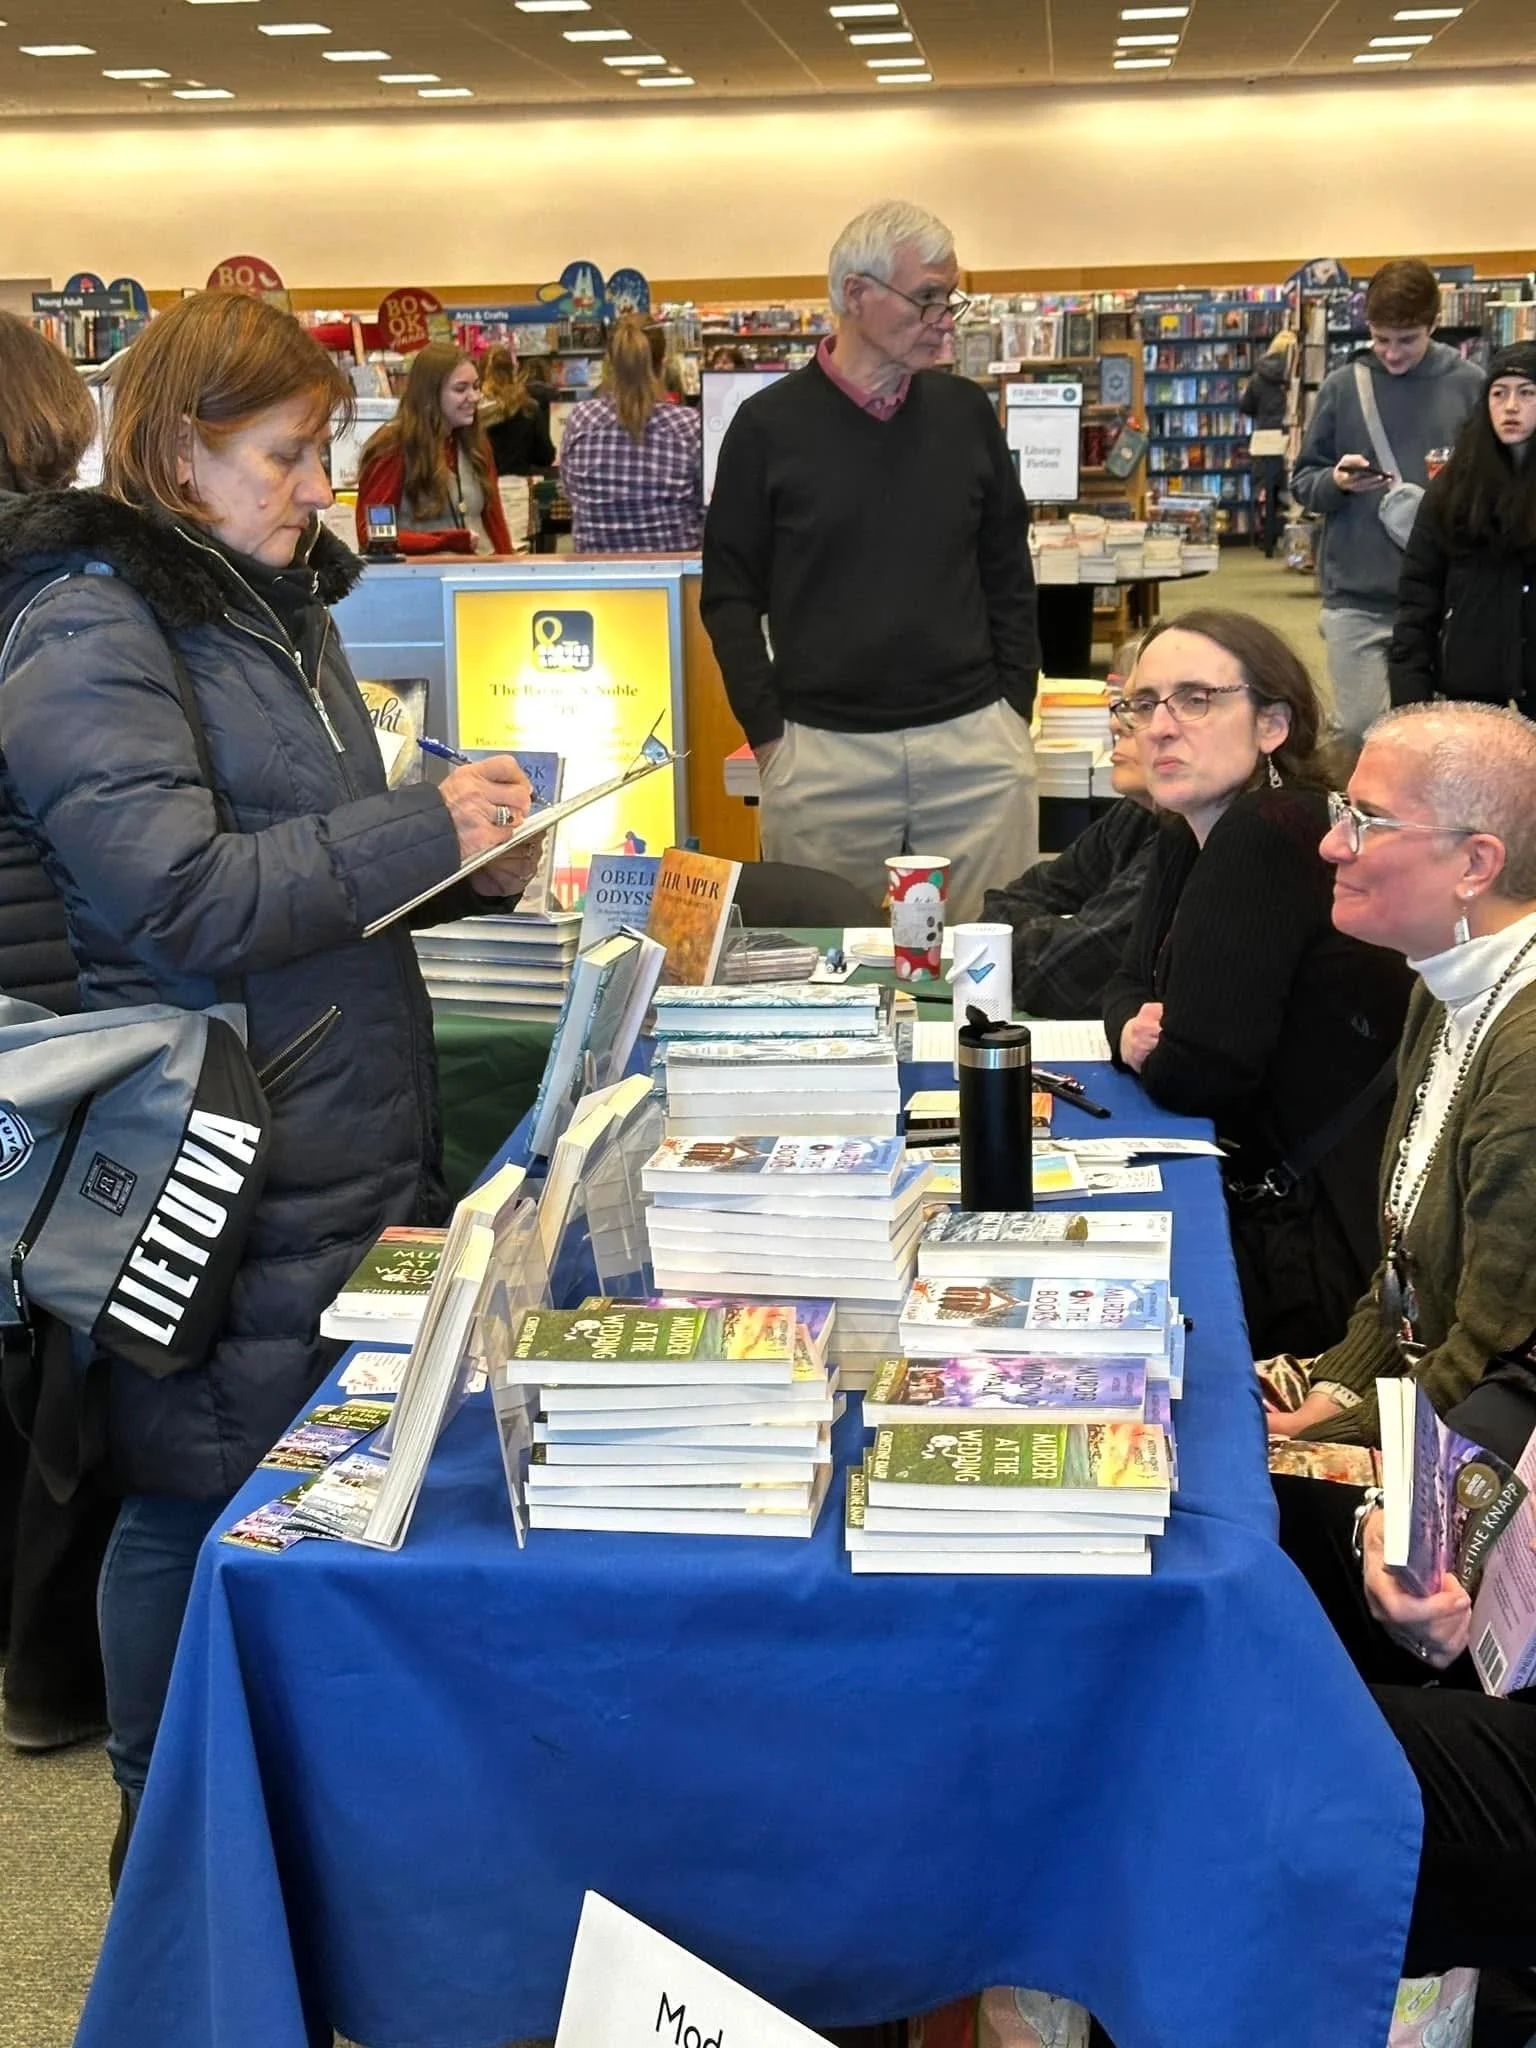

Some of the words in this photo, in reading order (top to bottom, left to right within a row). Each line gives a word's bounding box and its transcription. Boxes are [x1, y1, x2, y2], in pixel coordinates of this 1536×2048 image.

[38, 297, 62, 308] Young
[63, 297, 84, 306] Adult
[386, 295, 418, 317] BO
[387, 314, 420, 336] OK
[455, 311, 473, 321] Arts
[1024, 445, 1062, 458] Literary
[1026, 459, 1059, 469] Fiction
[489, 682, 520, 697] The
[106, 1109, 262, 1346] LIETUVA
[1031, 1289, 1059, 1323] BOOKS
[1068, 1289, 1095, 1306] ON
[1101, 1287, 1126, 1325] MURDER
[1065, 1306, 1091, 1323] THE
[591, 1313, 627, 1360] WEDDING
[636, 1321, 660, 1334] AT
[666, 1316, 696, 1356] MURDER
[630, 1334, 656, 1353] THE
[1072, 1365, 1099, 1401] MURDER
[876, 1430, 894, 1461] CHRISTINE
[953, 1428, 984, 1483] WEDDING
[993, 1437, 1020, 1452] AT
[993, 1453, 1019, 1476] THE
[1031, 1432, 1059, 1480] MURDER
[1482, 1481, 1519, 1529] KNAPP
